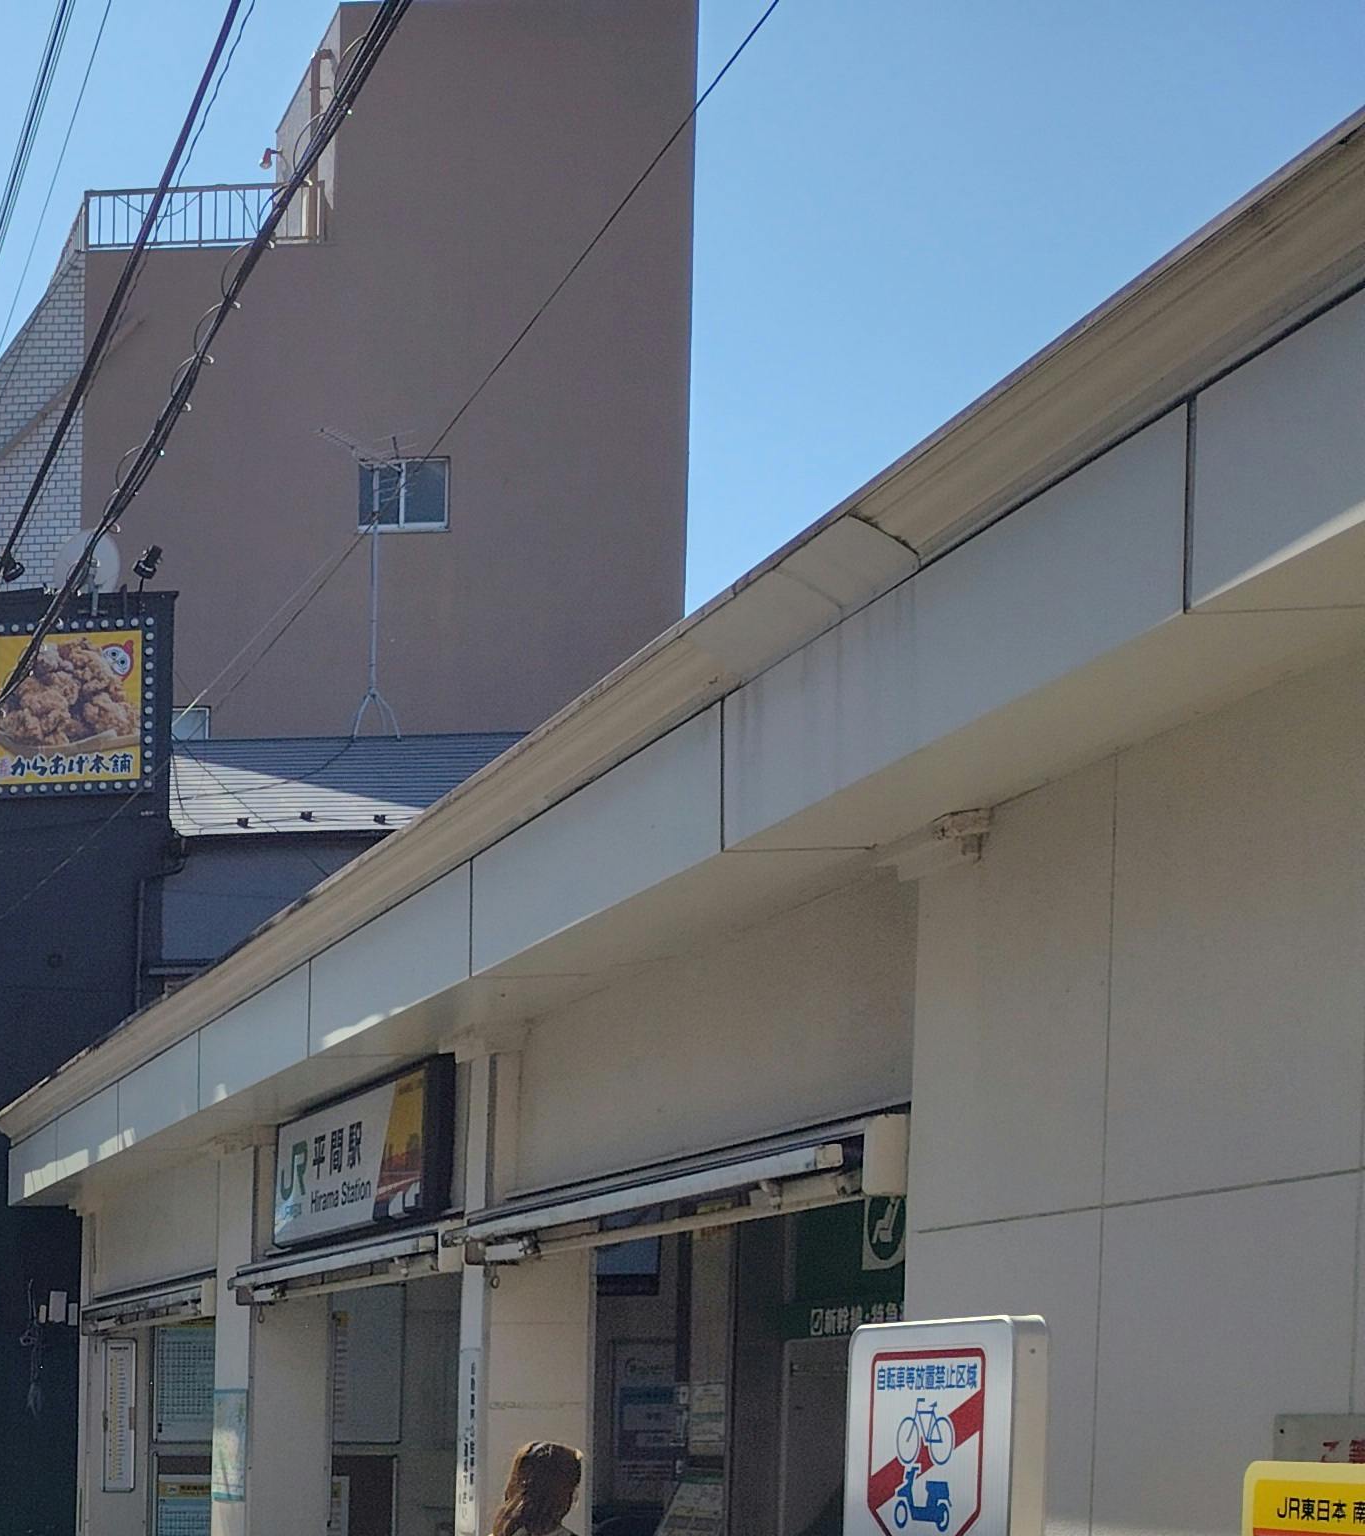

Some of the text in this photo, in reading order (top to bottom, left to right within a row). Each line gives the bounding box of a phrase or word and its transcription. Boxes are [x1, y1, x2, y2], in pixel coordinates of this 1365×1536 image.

[11, 752, 134, 777] からあげ本舗
[312, 1121, 363, 1180] 平間駅
[280, 1140, 309, 1200] JR
[310, 1177, 372, 1213] Hirama Station
[876, 1363, 978, 1392] 自転車等放置禁止区域
[1276, 1496, 1348, 1523] JR東日本
